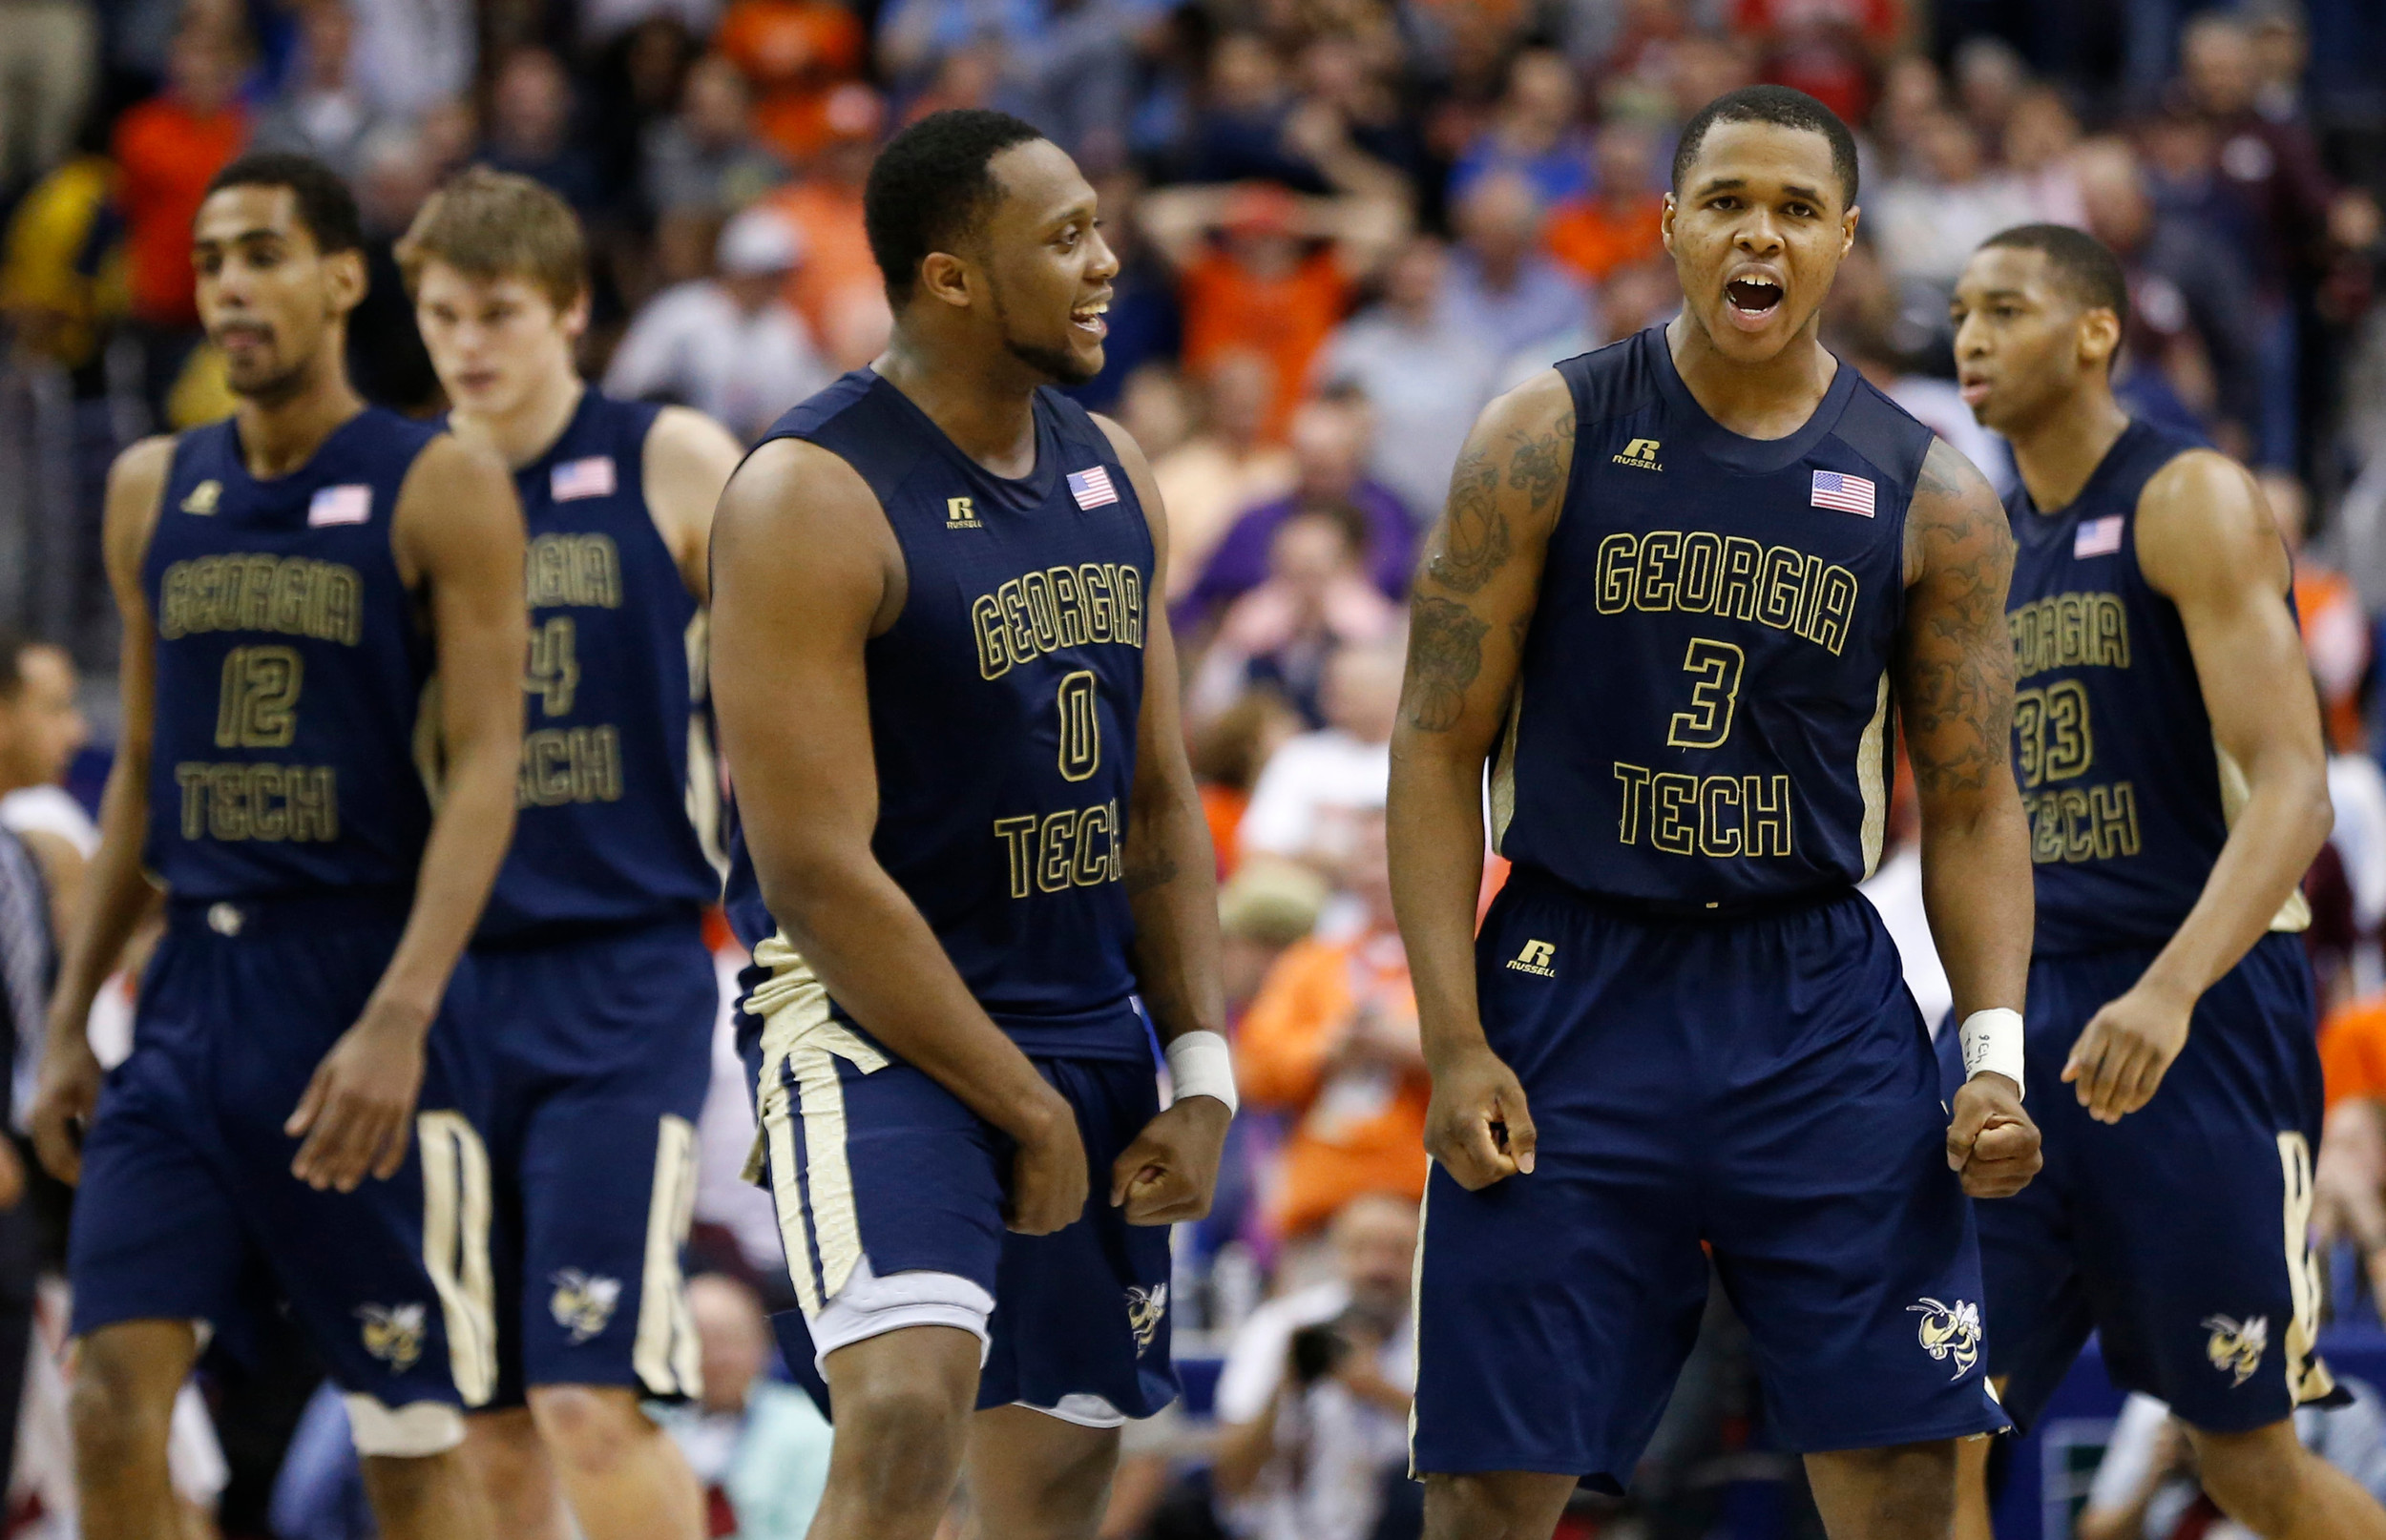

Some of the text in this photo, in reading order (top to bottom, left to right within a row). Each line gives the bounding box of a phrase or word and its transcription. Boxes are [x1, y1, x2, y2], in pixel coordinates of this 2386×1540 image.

[1612, 454, 1664, 472] RUSSELL
[946, 520, 983, 531] RUSSELL
[159, 551, 364, 647] GEORGIA
[972, 562, 1144, 681] GEORGIA
[1595, 531, 1859, 657] GEORGIA
[215, 644, 304, 748] 12
[1057, 669, 1101, 783] 0
[1666, 636, 1746, 750] 3
[2013, 677, 2094, 789] 33
[175, 760, 340, 843] TECH
[516, 723, 623, 809] CH
[1613, 760, 1791, 857] TECH
[994, 796, 1122, 899] TECH
[1506, 959, 1557, 978] RUSSELL
